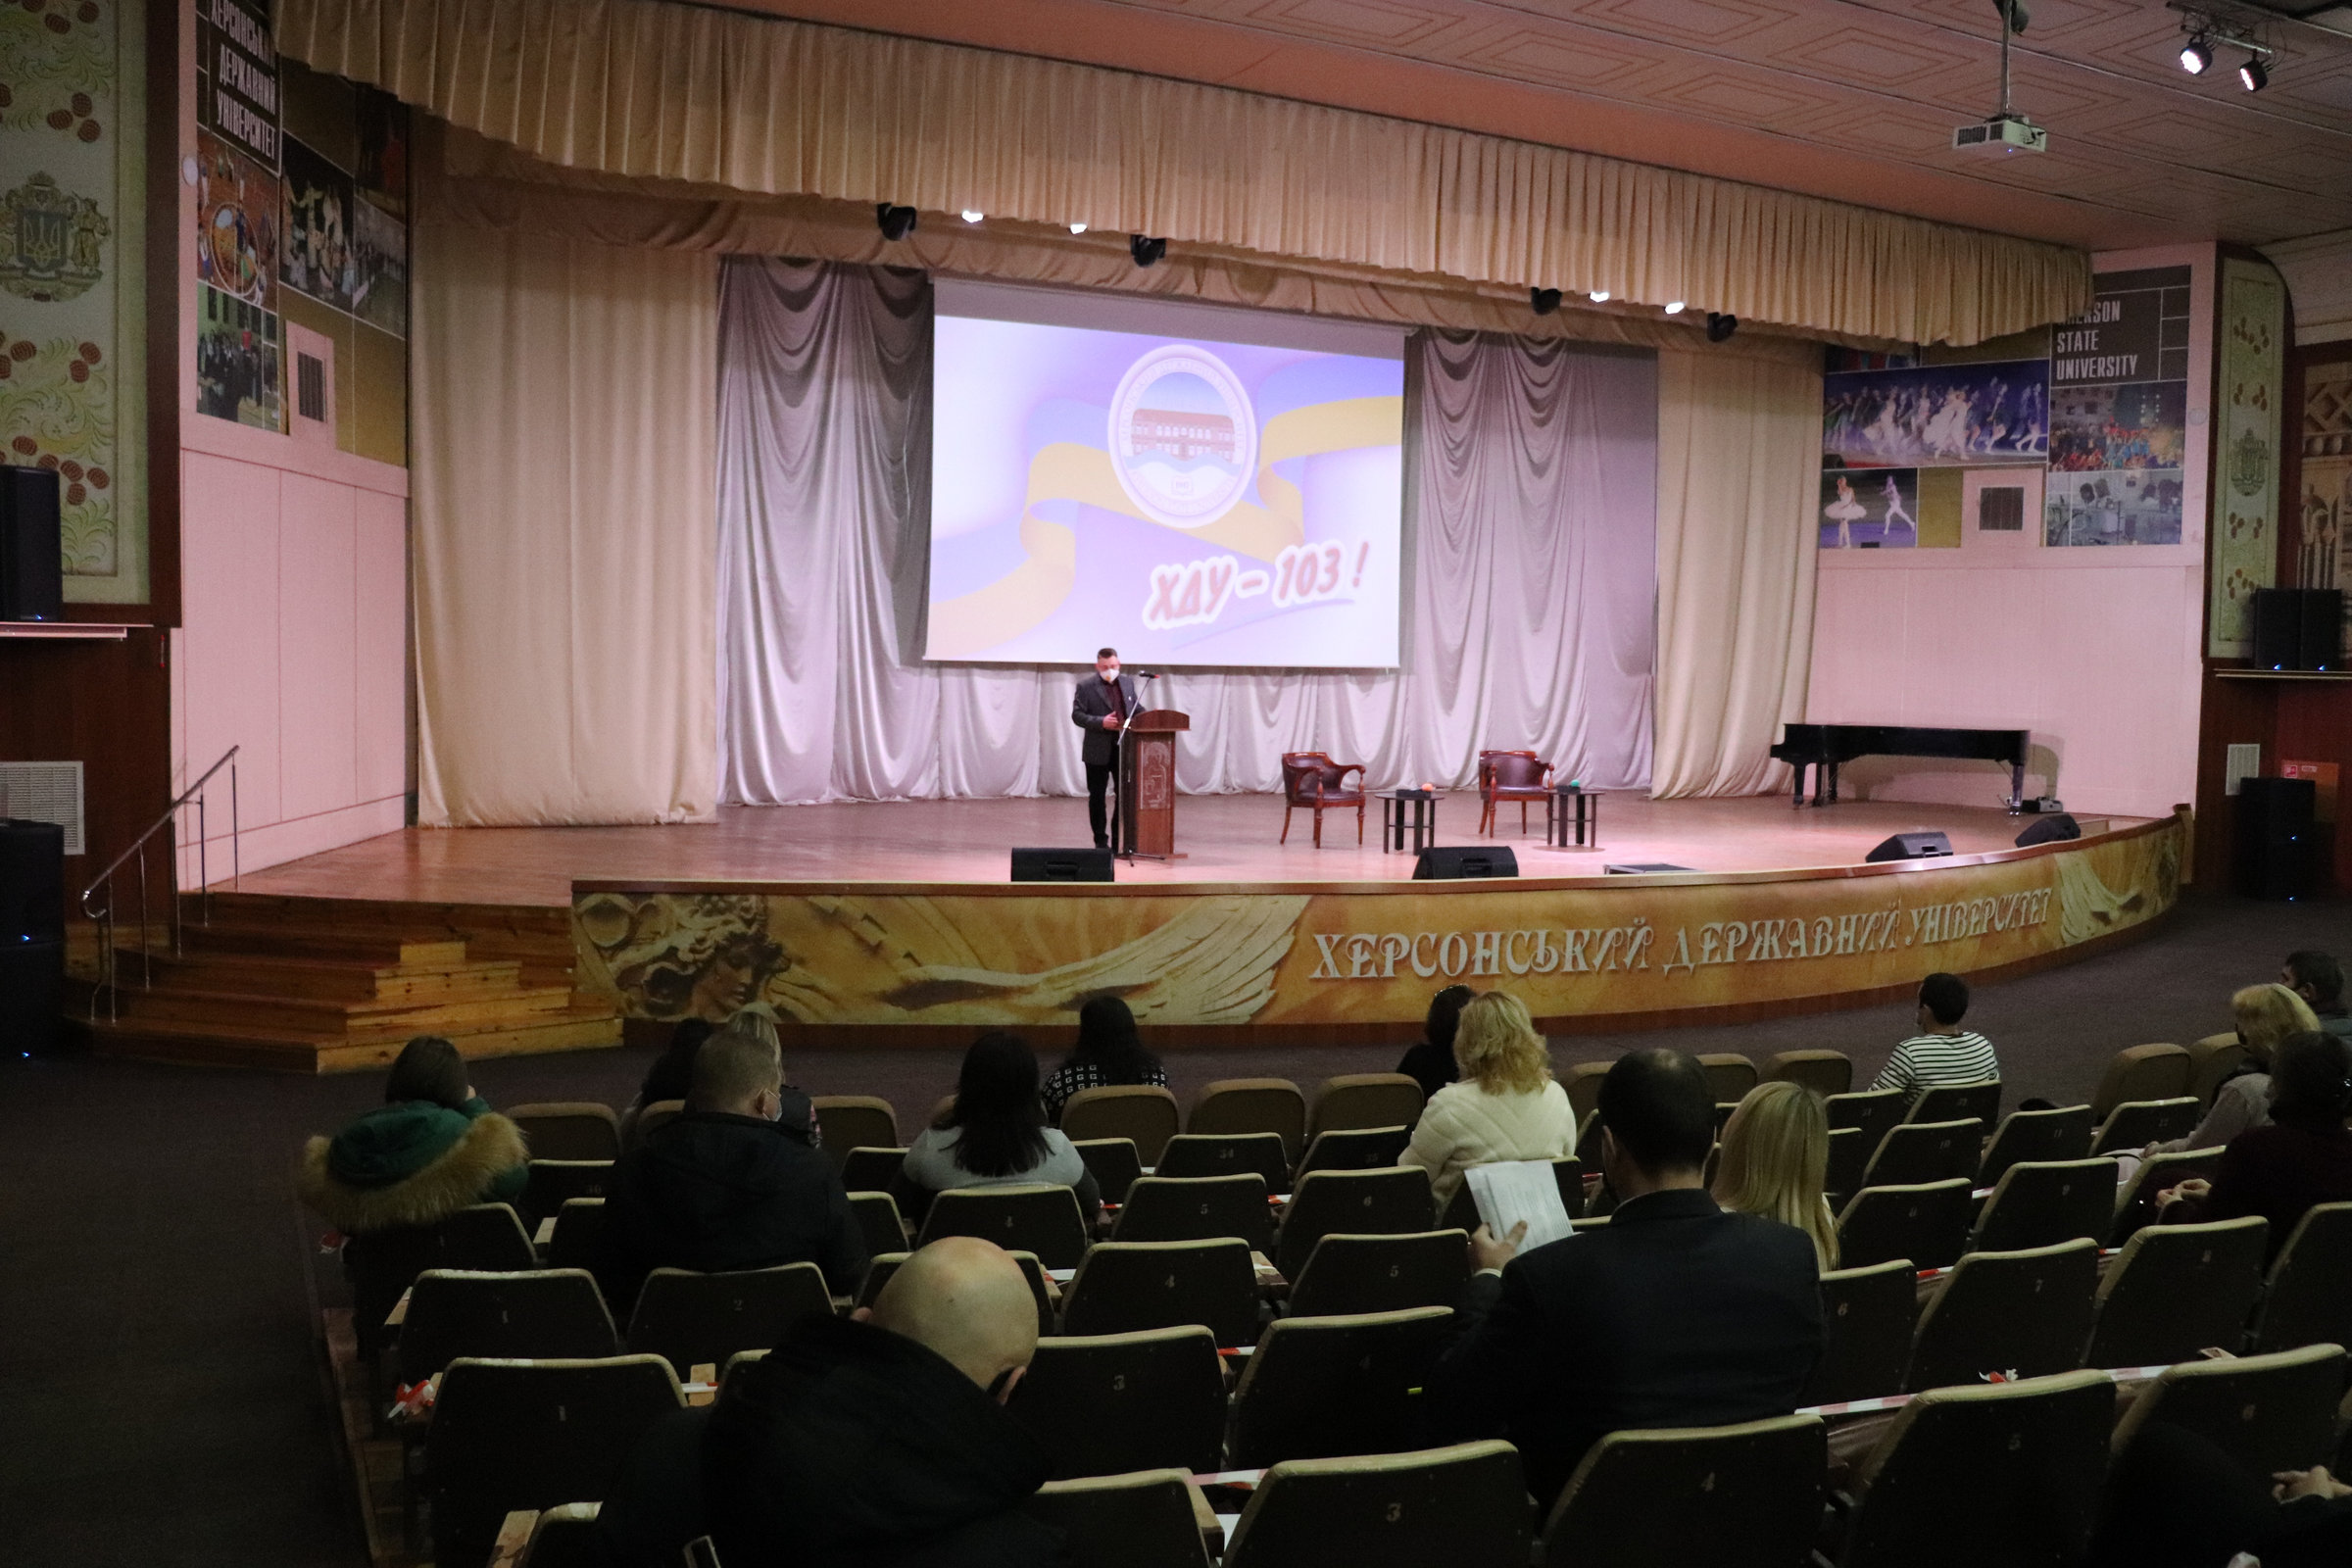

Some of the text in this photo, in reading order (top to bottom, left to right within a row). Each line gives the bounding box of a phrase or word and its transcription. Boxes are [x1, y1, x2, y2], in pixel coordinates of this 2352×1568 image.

[219, 43, 276, 116] ДЕРЖАВНИЙ
[217, 88, 276, 160] УНІВЕРСИТЕТ
[2057, 329, 2099, 354] STATE
[2056, 354, 2138, 380] UNIVERSITY
[1308, 886, 2054, 978] ХЕРСОНСЬКИЙ ДЕРЖАВНИЙ УНІВЕРСИТЕТ
[1164, 1273, 1176, 1288] 4
[1390, 1265, 1400, 1278] 5
[733, 1298, 744, 1311] 2
[1838, 1302, 1849, 1317] 6
[1112, 1374, 1126, 1392] 3
[1701, 1471, 1716, 1492] 4
[1386, 1502, 1402, 1522] 3
